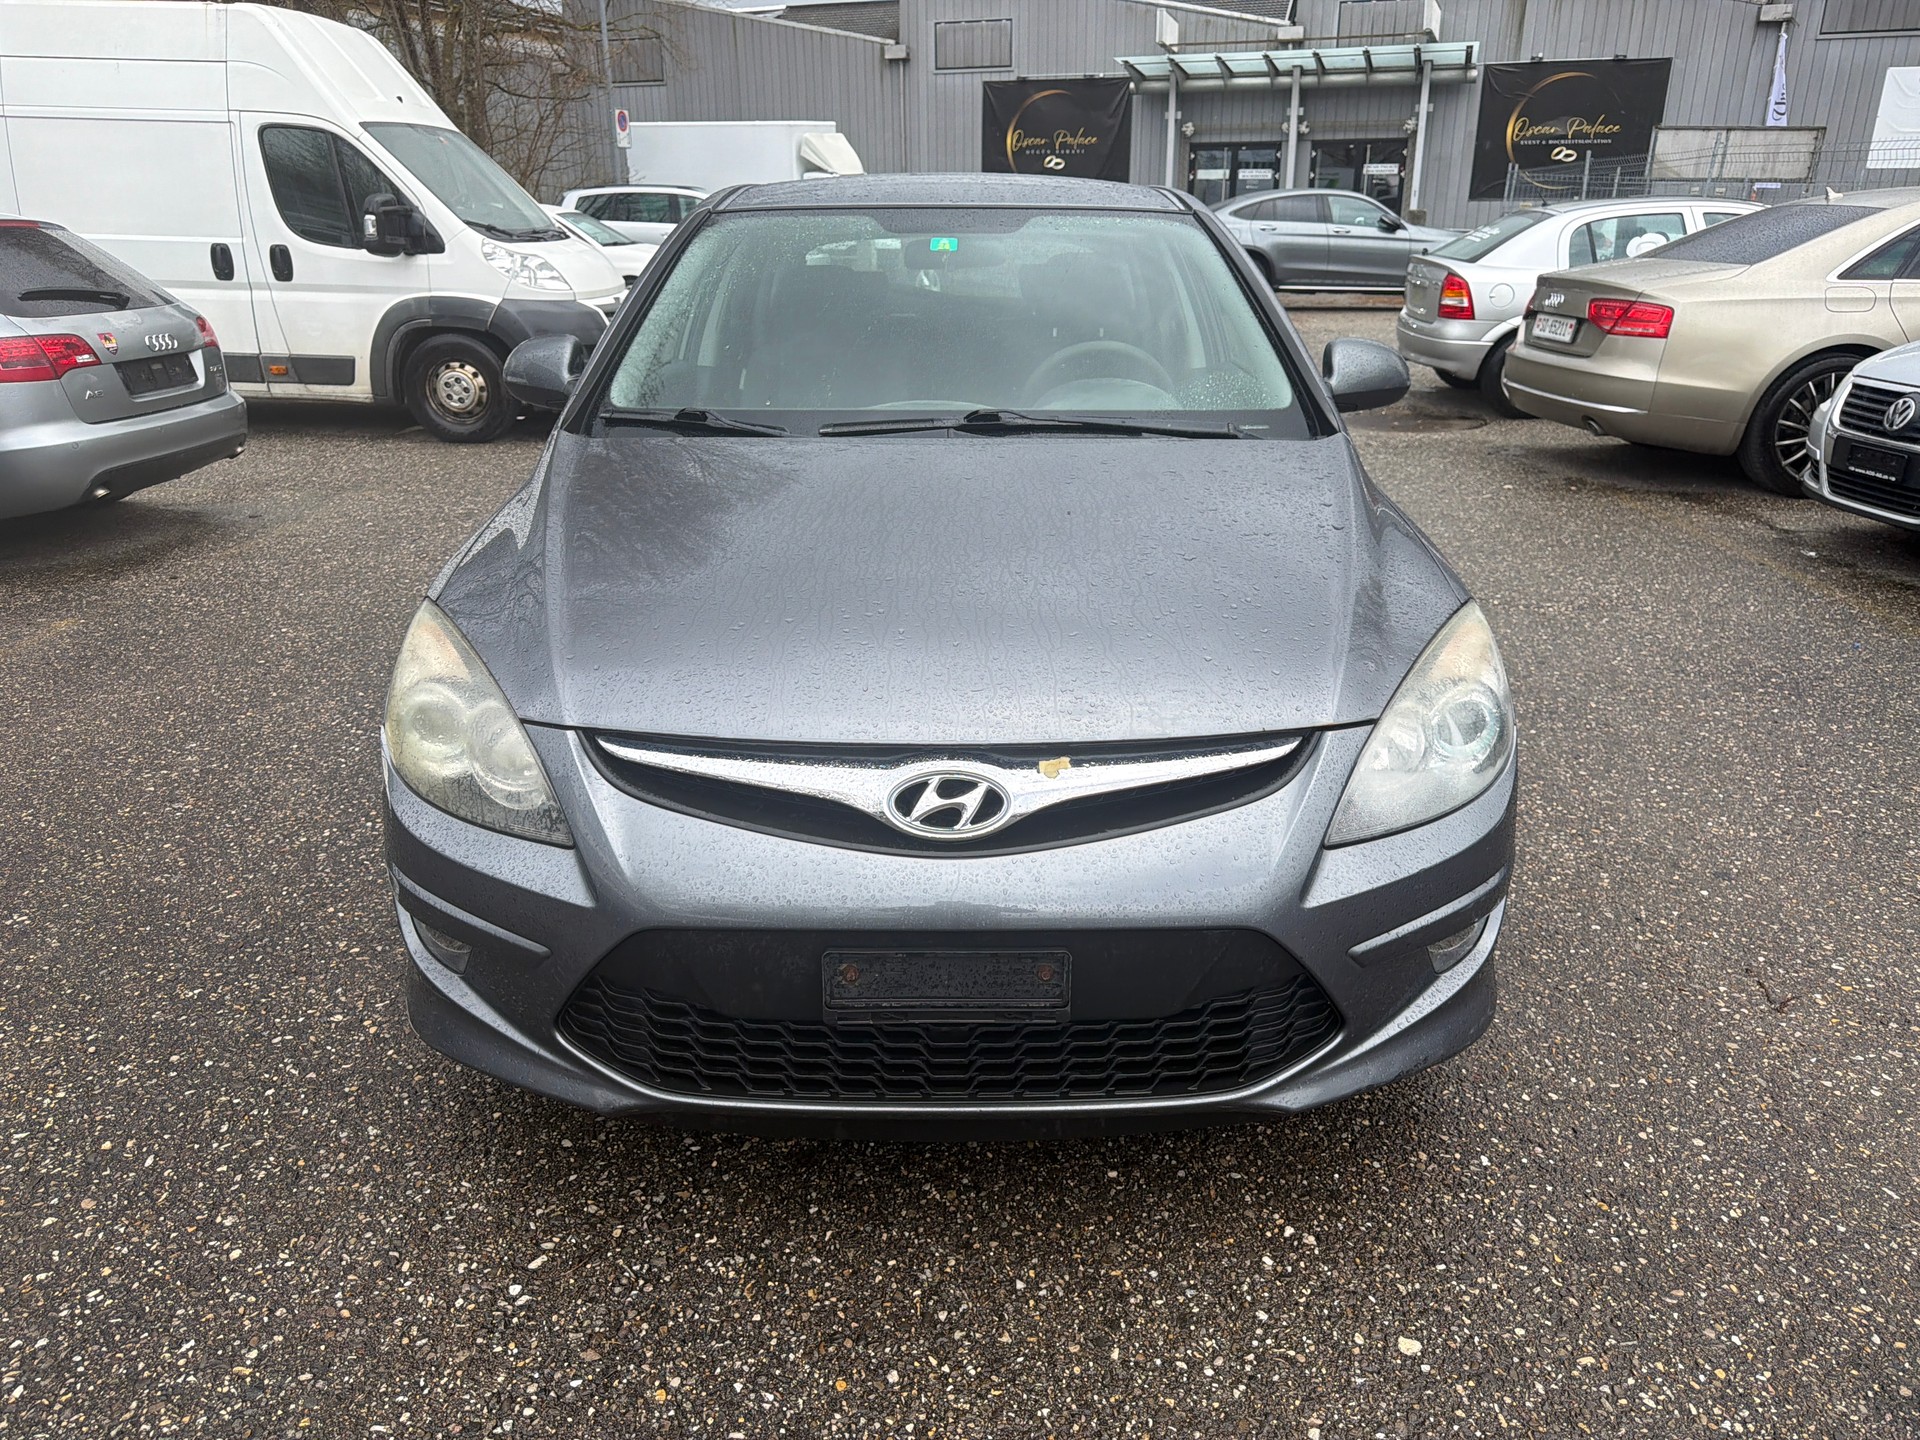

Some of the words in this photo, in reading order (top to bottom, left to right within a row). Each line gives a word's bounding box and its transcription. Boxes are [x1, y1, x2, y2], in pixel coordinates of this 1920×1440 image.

[1012, 129, 1047, 152] Oscar
[1053, 127, 1099, 150] Palace
[1512, 117, 1561, 142] Oscar
[1566, 114, 1622, 139] Palace
